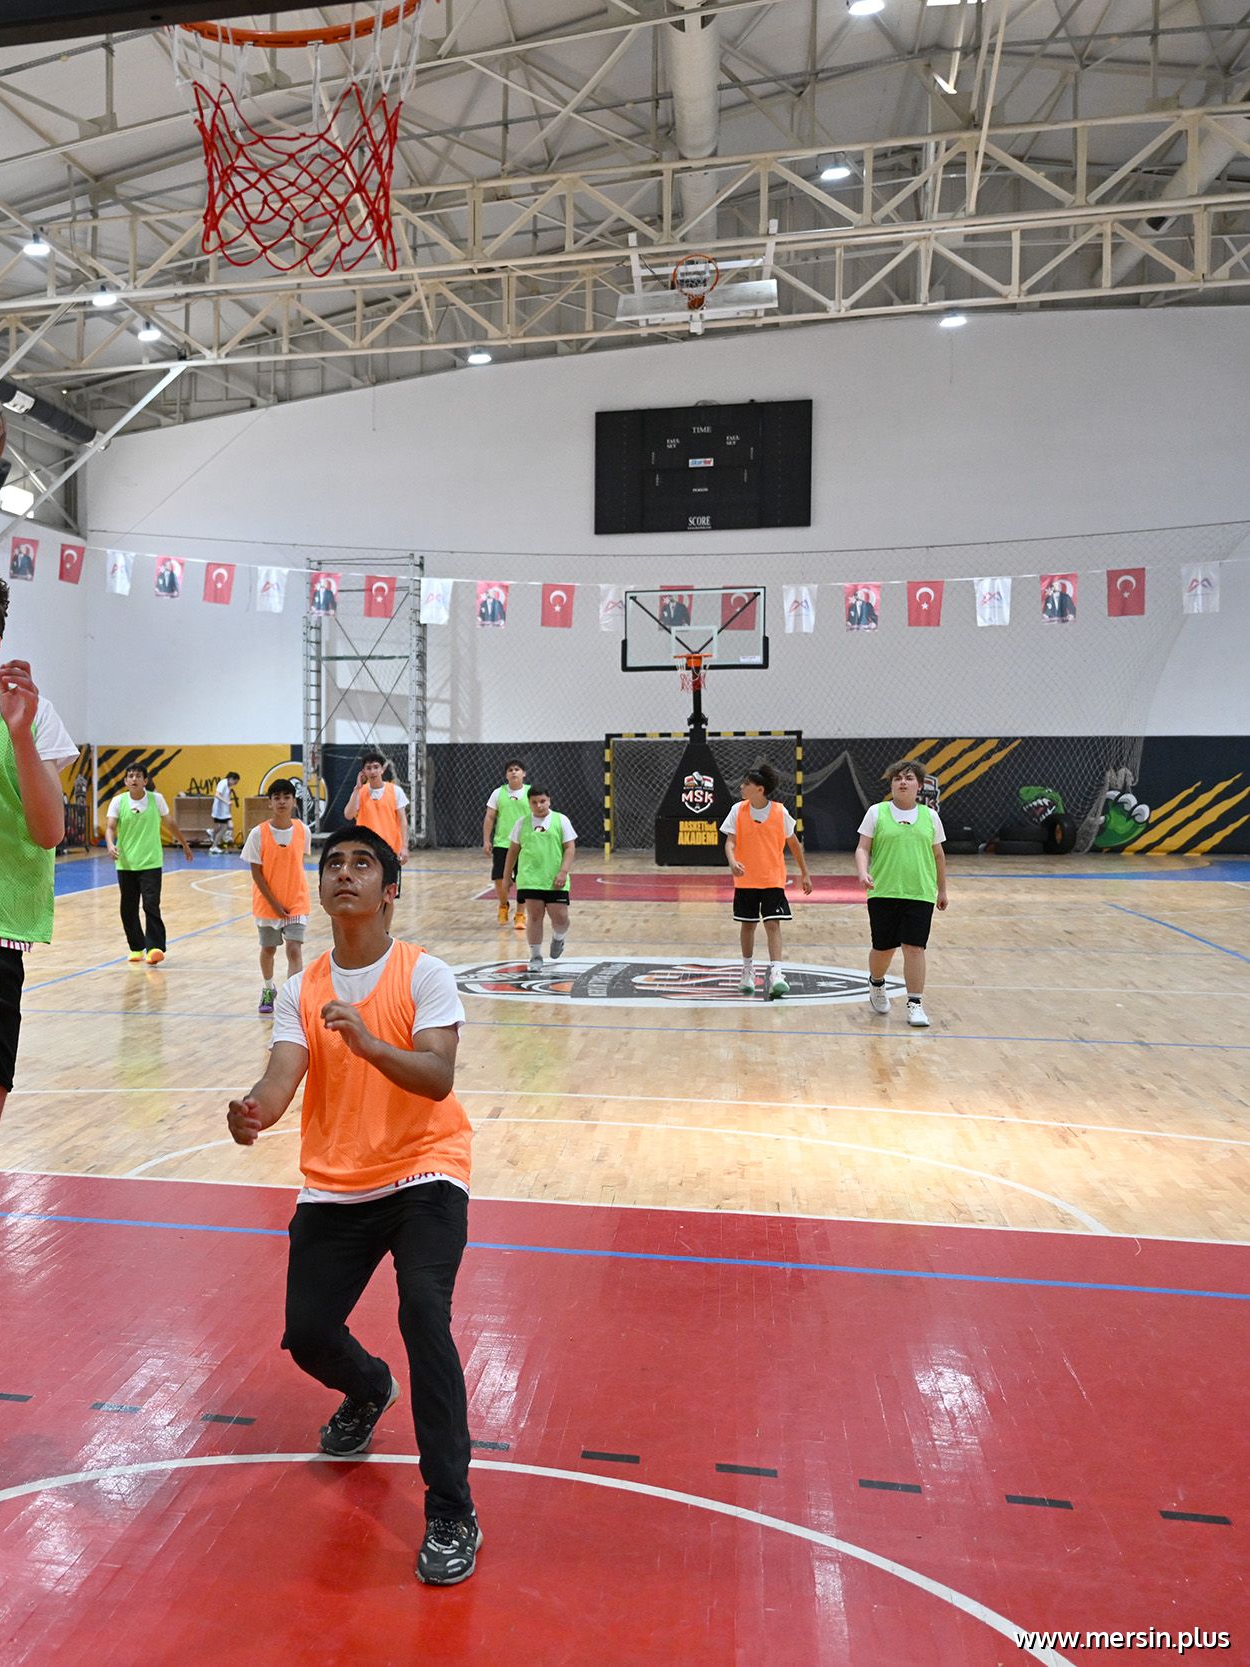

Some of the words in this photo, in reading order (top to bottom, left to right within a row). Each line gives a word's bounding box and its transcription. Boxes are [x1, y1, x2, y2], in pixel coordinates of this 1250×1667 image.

[692, 426, 712, 434] TIME
[688, 516, 711, 526] SCORE
[681, 789, 714, 804] MSK
